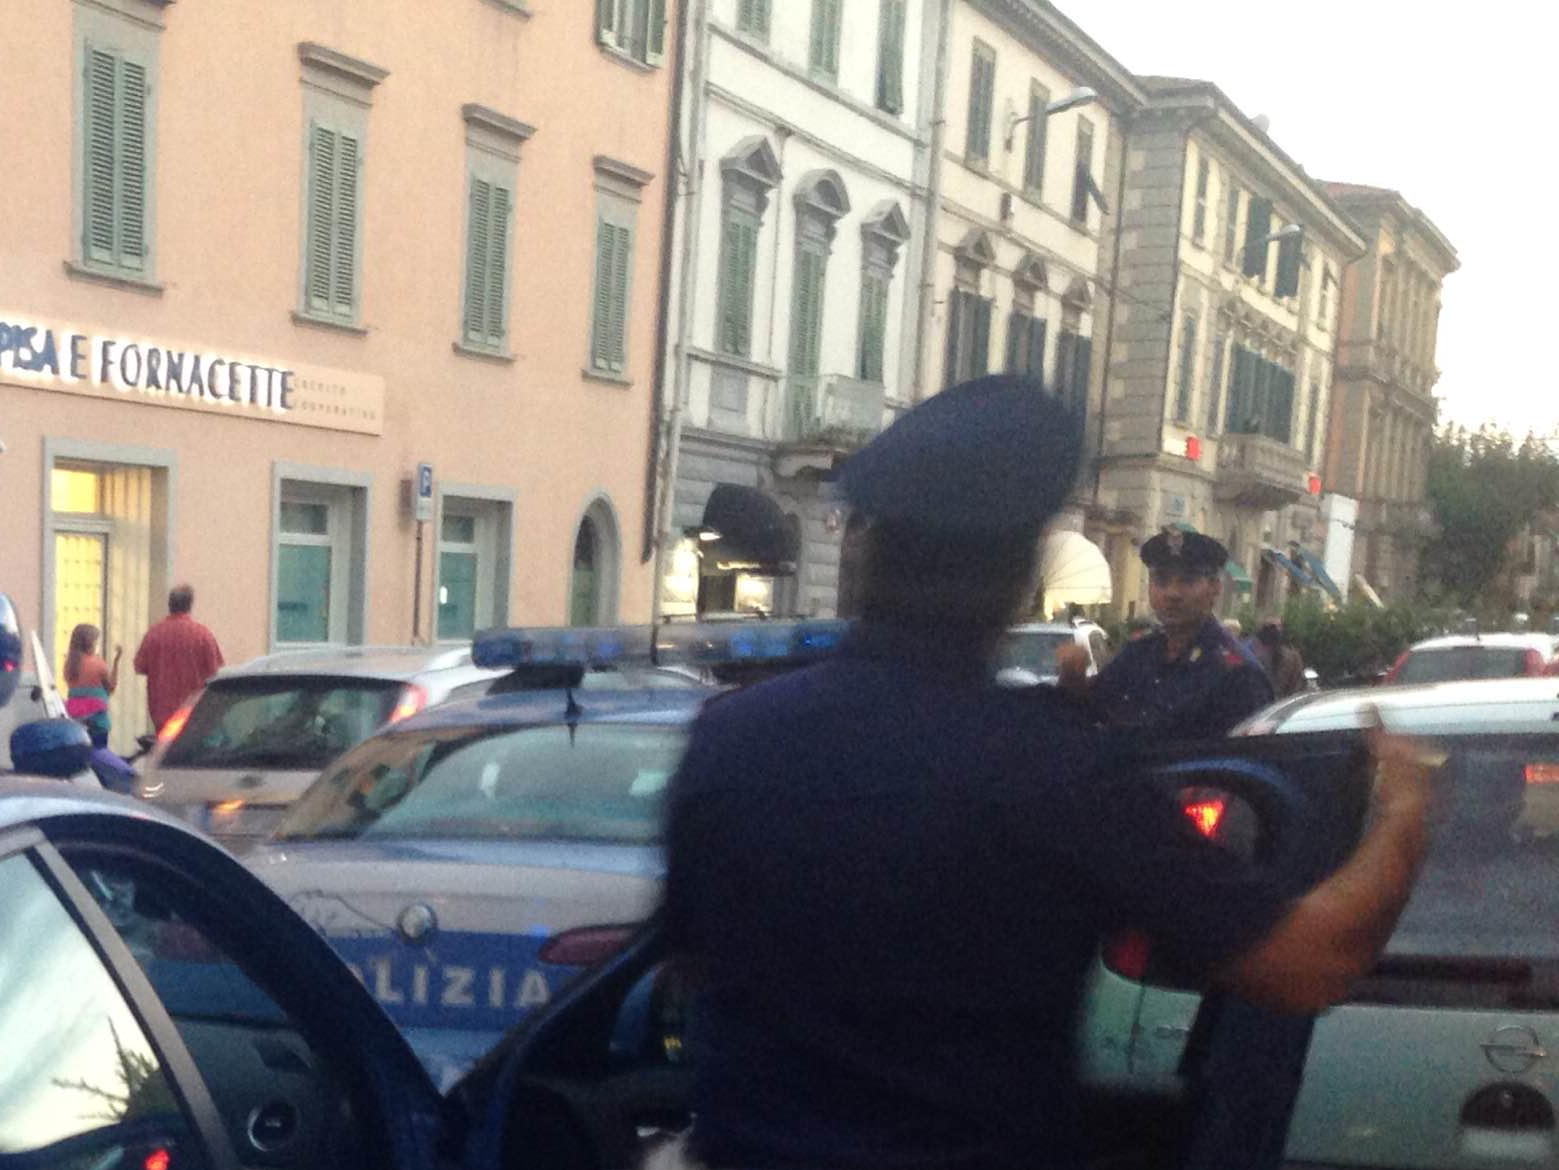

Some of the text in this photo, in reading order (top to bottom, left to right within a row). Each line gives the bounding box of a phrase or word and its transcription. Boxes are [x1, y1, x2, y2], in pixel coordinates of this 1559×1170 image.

[70, 334, 87, 380] E
[100, 340, 295, 410] FORNACETTE
[348, 956, 551, 1007] LIZIA
